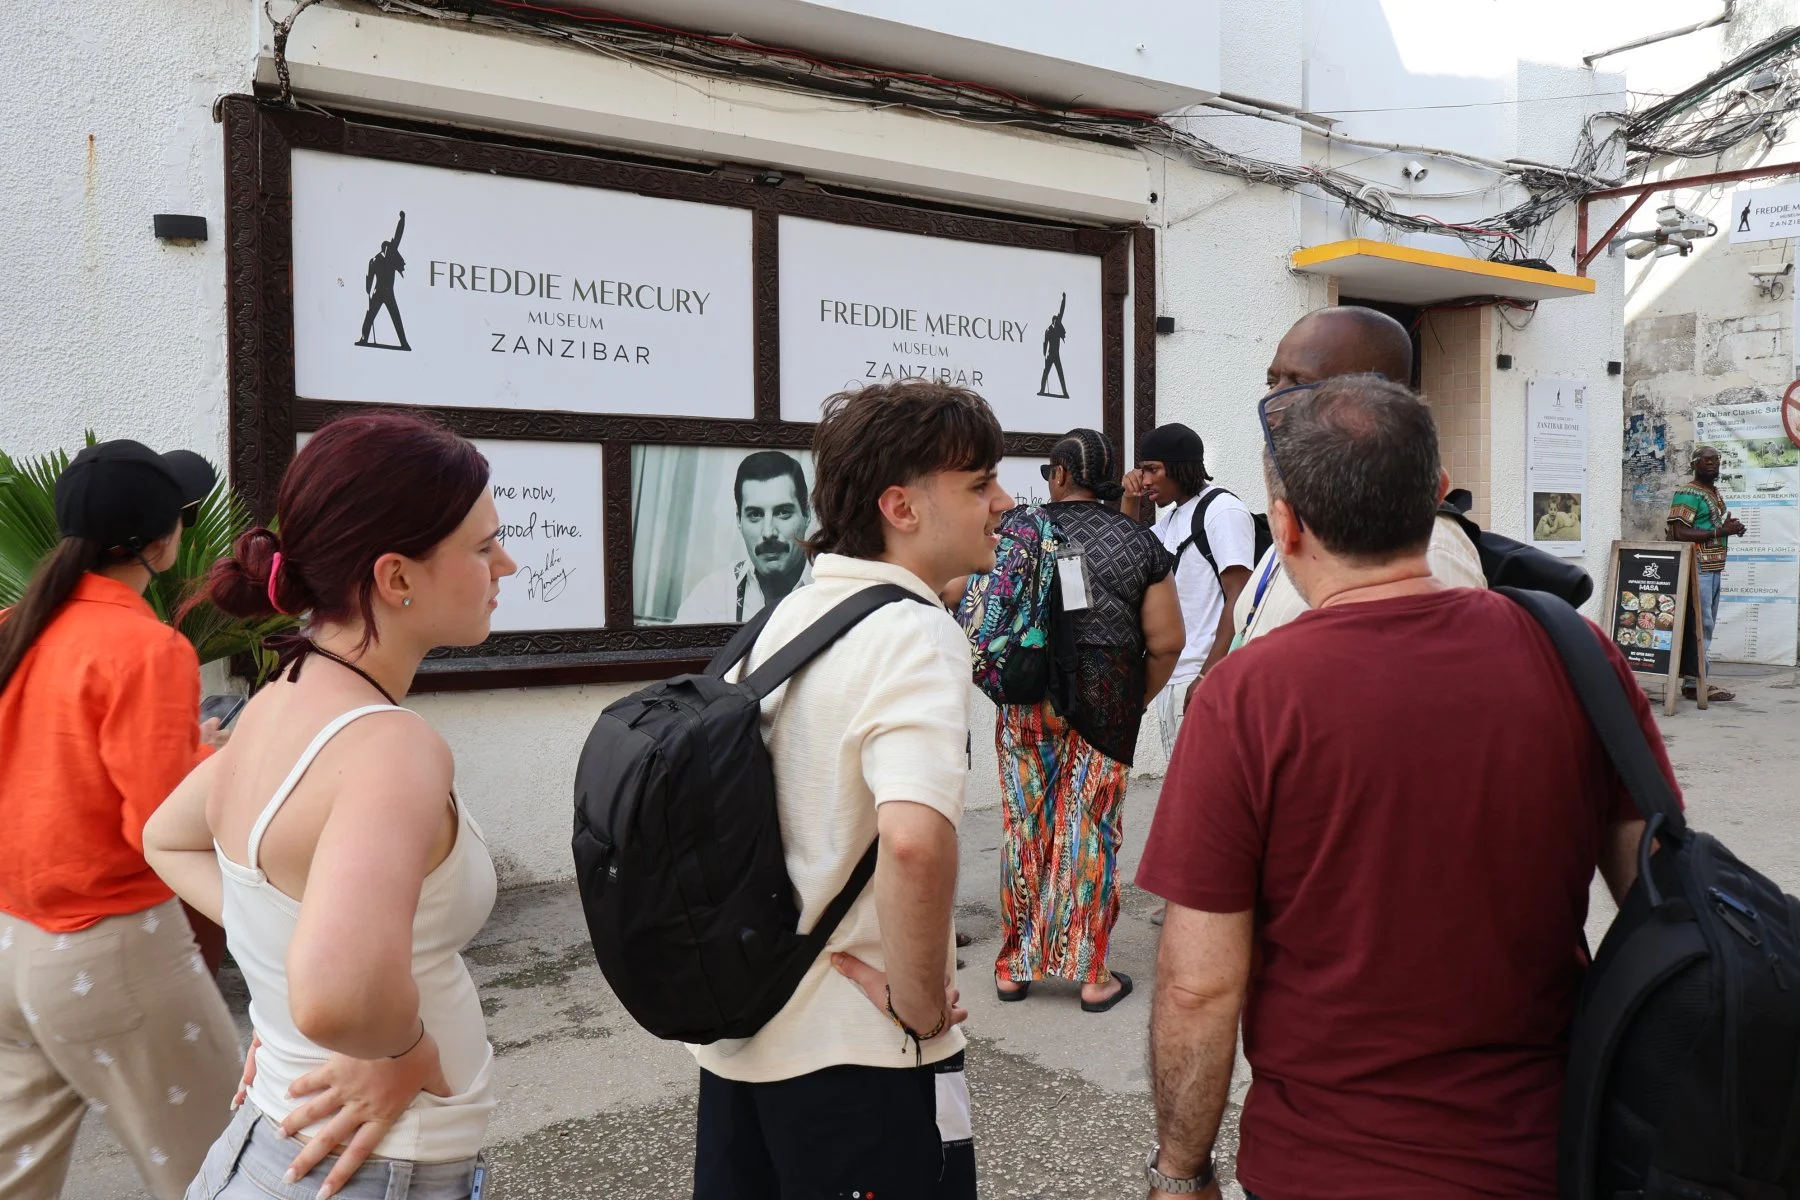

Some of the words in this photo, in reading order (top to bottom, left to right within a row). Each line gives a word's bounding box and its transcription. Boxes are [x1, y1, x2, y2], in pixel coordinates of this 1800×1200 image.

[1755, 204, 1791, 215] FREDDIE
[430, 260, 562, 300] FREDDIE
[572, 277, 711, 316] MERCURY
[527, 311, 605, 330] MUSEUM
[819, 299, 917, 332] FREDDIE
[924, 311, 1029, 344] MERCURY
[490, 333, 651, 365] ZANZIBAR
[892, 341, 949, 358] MUSEUM
[865, 360, 984, 387] ZANZIBAR
[1732, 408, 1763, 416] Classic
[493, 485, 517, 500] me
[522, 486, 556, 504] now,
[496, 511, 537, 548] good
[541, 519, 582, 539] time.
[1639, 584, 1659, 592] MASA
